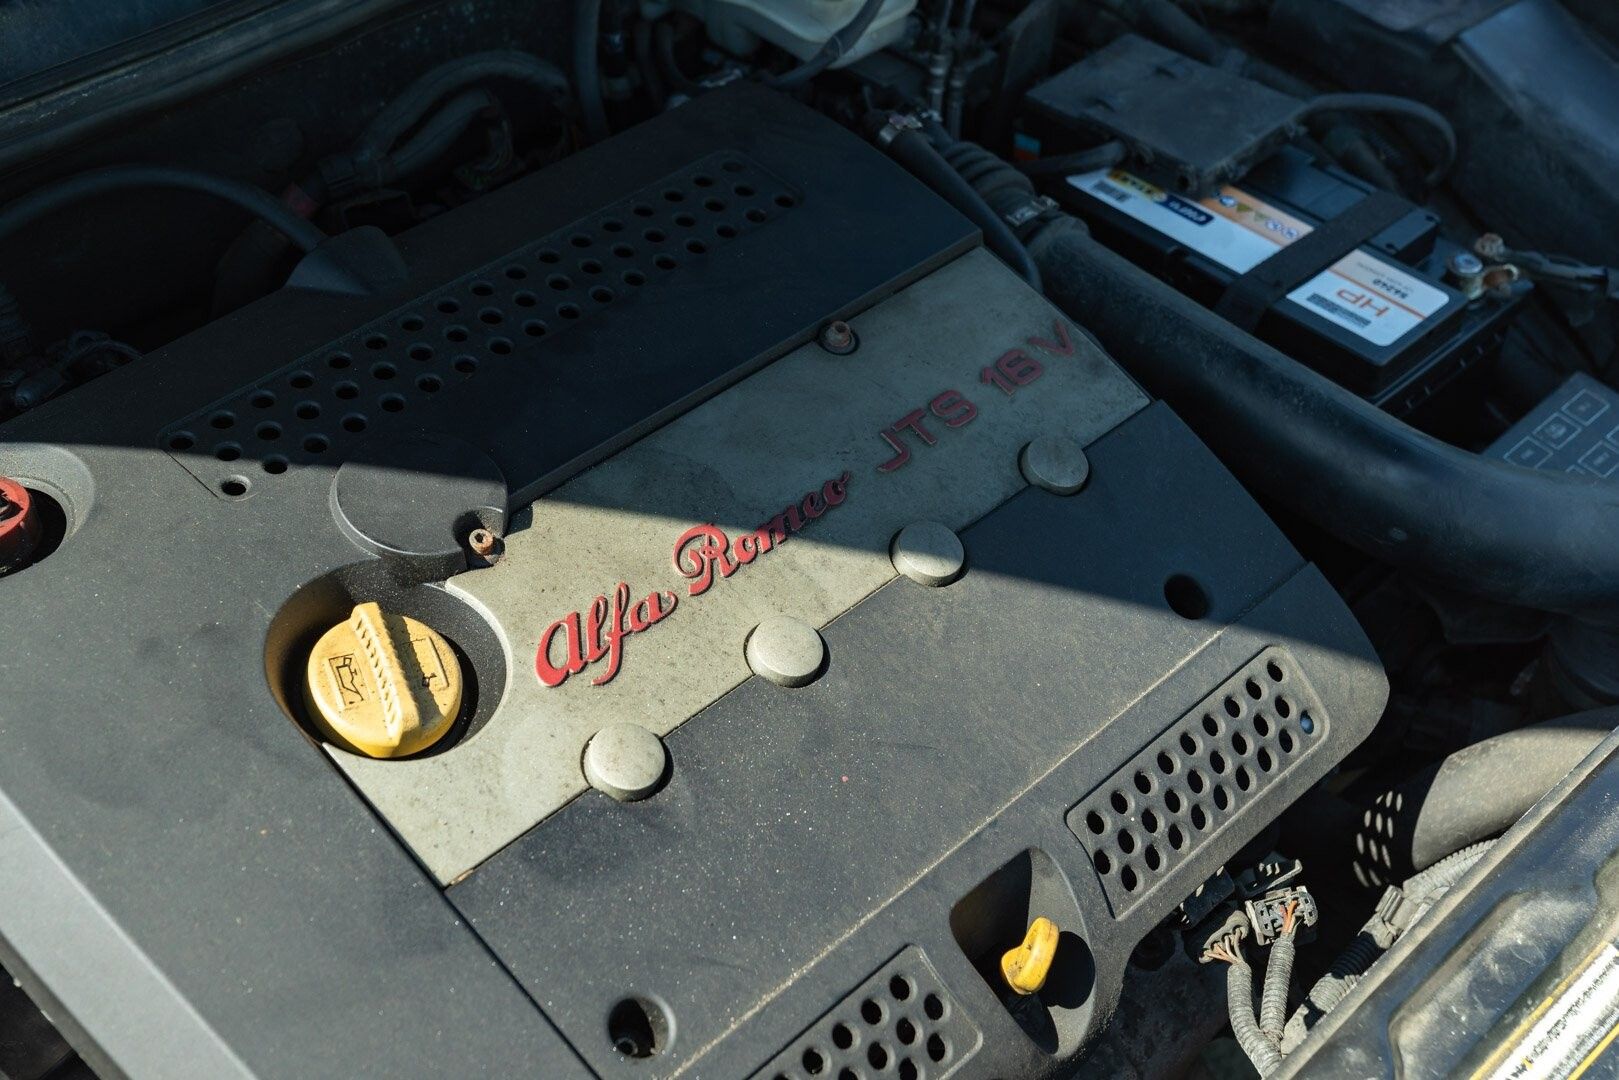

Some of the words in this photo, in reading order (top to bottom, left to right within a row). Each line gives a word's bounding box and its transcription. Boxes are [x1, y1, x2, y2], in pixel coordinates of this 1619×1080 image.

[1336, 288, 1390, 317] HP
[876, 389, 978, 472] JTS
[535, 581, 679, 688] Alfa
[672, 470, 853, 597] Romeo
